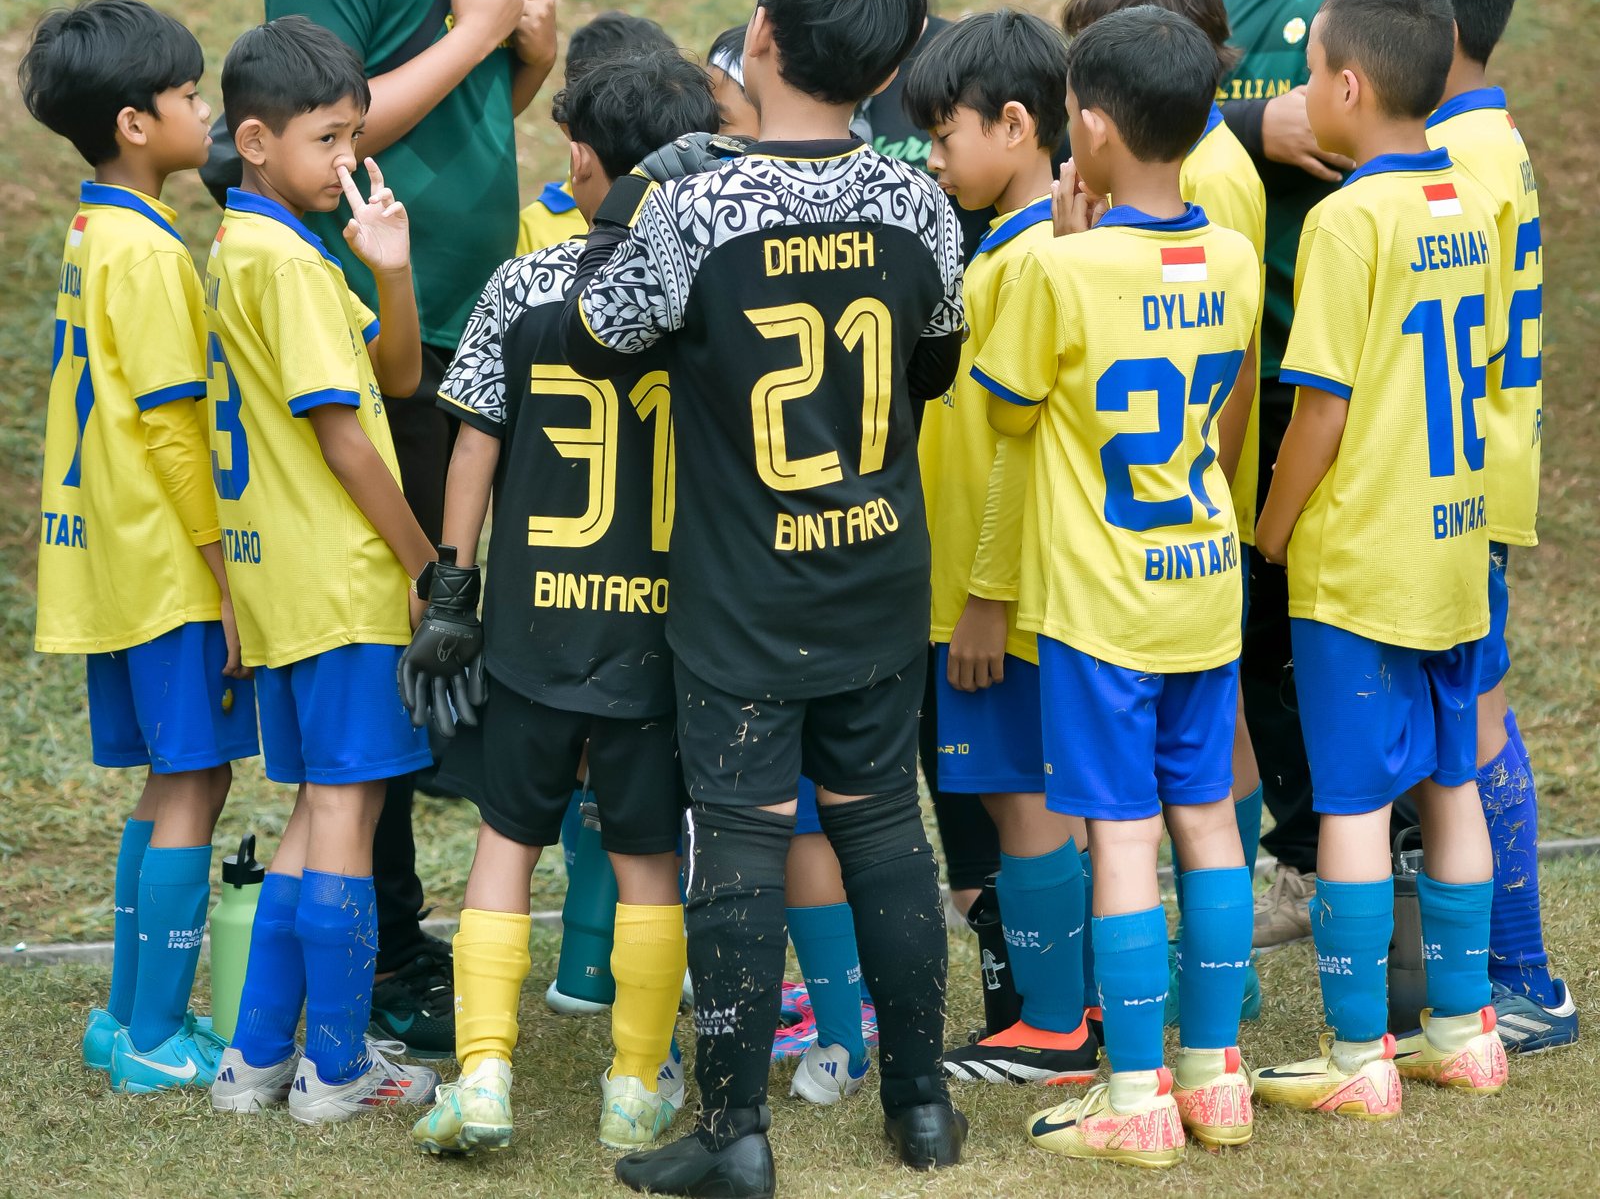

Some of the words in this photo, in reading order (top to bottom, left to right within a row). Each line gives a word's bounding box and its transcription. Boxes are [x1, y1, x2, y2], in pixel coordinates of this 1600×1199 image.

[764, 232, 875, 277] DANISH
[1410, 230, 1490, 273] JESAIAH
[1142, 291, 1225, 331] DYLAN
[743, 297, 892, 491] 21
[528, 364, 676, 552] 31
[1096, 349, 1246, 533] 27
[222, 528, 261, 564] TARO
[775, 498, 899, 552] BINTARO
[1144, 532, 1238, 581] BINTARO
[534, 571, 669, 614] BINTARO
